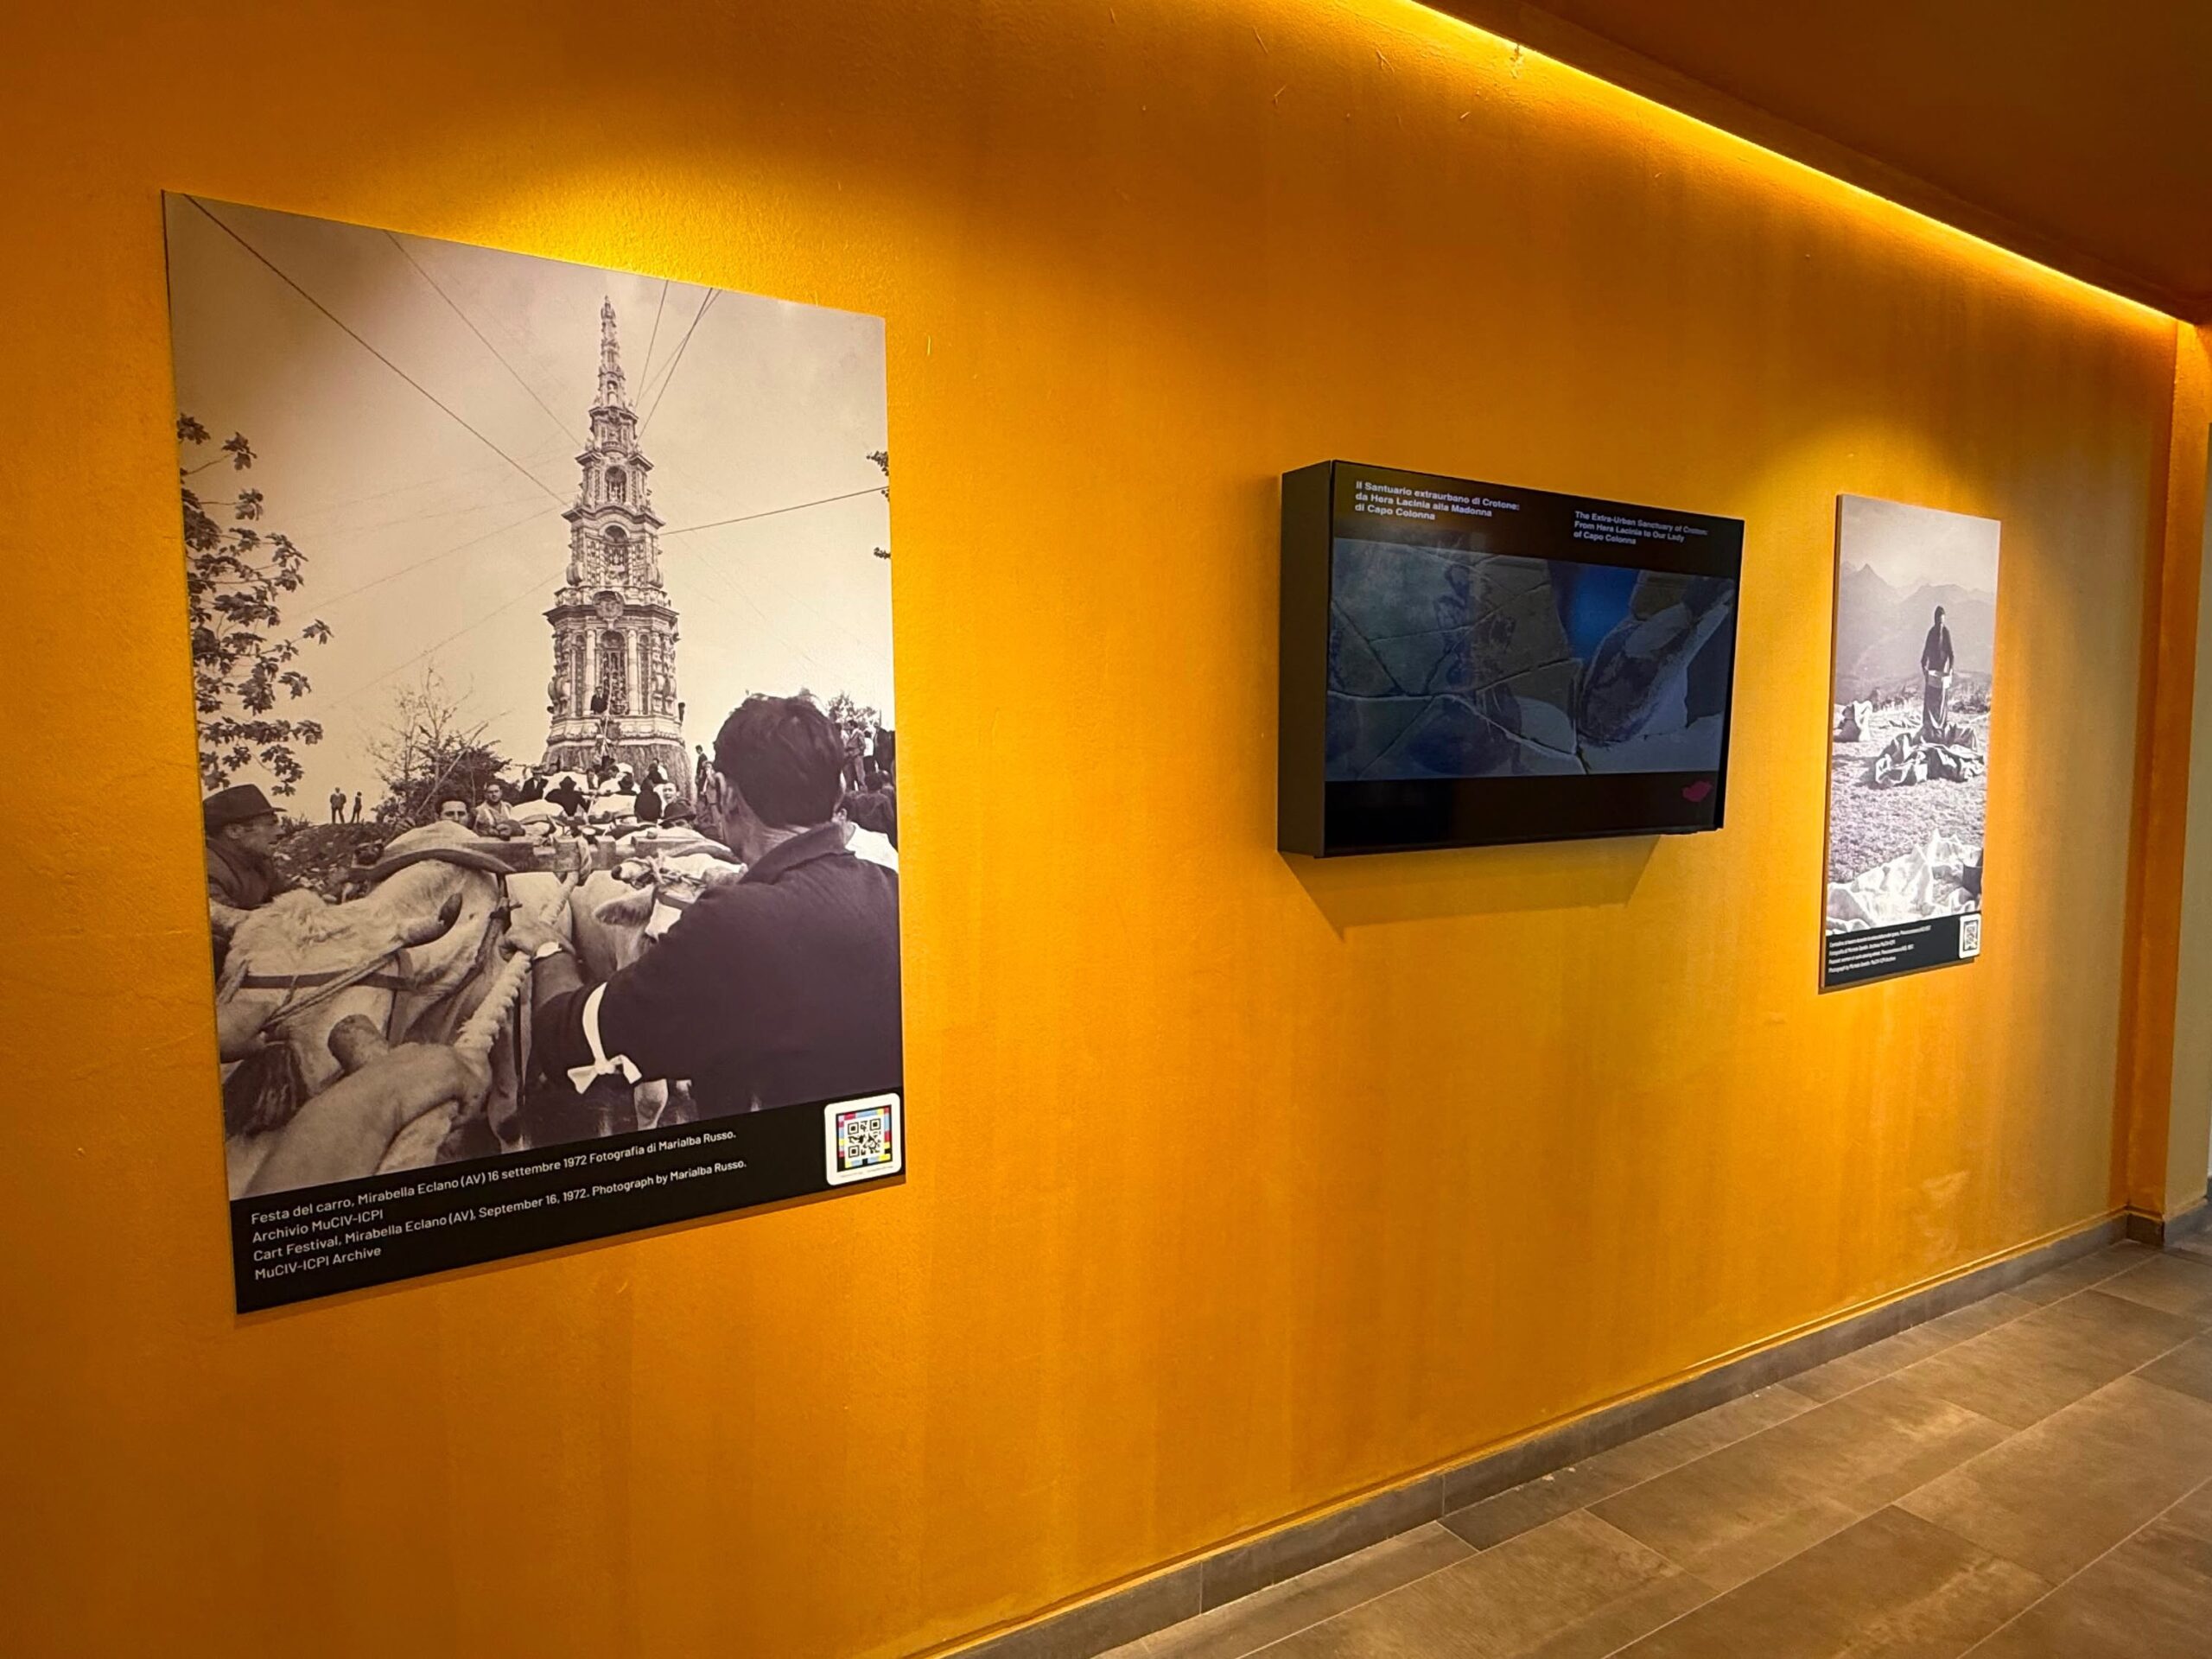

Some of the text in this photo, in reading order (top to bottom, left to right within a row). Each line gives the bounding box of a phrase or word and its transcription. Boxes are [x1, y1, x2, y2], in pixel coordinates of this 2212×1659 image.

[1355, 492, 1492, 517] da Hera Lacinia alla Madonna
[1364, 482, 1412, 497] Santuario
[1414, 487, 1470, 504] extraurbano
[1471, 496, 1480, 505] di
[1355, 503, 1435, 520] di Capo Colonna
[1574, 511, 1590, 520] The
[1592, 513, 1636, 525] Extra-Urban
[1574, 521, 1594, 530] From
[1596, 523, 1614, 532] Hera
[1616, 526, 1642, 536] Lacinia
[1652, 531, 1665, 539] Our
[1667, 533, 1685, 543] Lady
[1583, 531, 1604, 541] Capo
[1605, 534, 1637, 545] Colonna
[251, 1130, 736, 1225] Festa del carro, Mirabella Eclano (AV) 16 settembre 1972 Fotografia di Marialba Russo.
[254, 1247, 283, 1262] Cart
[286, 1235, 342, 1255] Festival,
[346, 1224, 403, 1244] Mirabella
[405, 1218, 447, 1232] Eclano
[478, 1196, 543, 1218] September
[545, 1193, 560, 1205] 16,
[563, 1188, 589, 1202] 1972.
[592, 1175, 654, 1197] Photograph
[656, 1173, 668, 1185] by
[670, 1166, 712, 1182] Marialba
[714, 1160, 747, 1173] Russo.
[252, 1209, 384, 1243] Archivio MuCIV-ICPI
[255, 1247, 382, 1281] MuCIV-ICPI Archive
